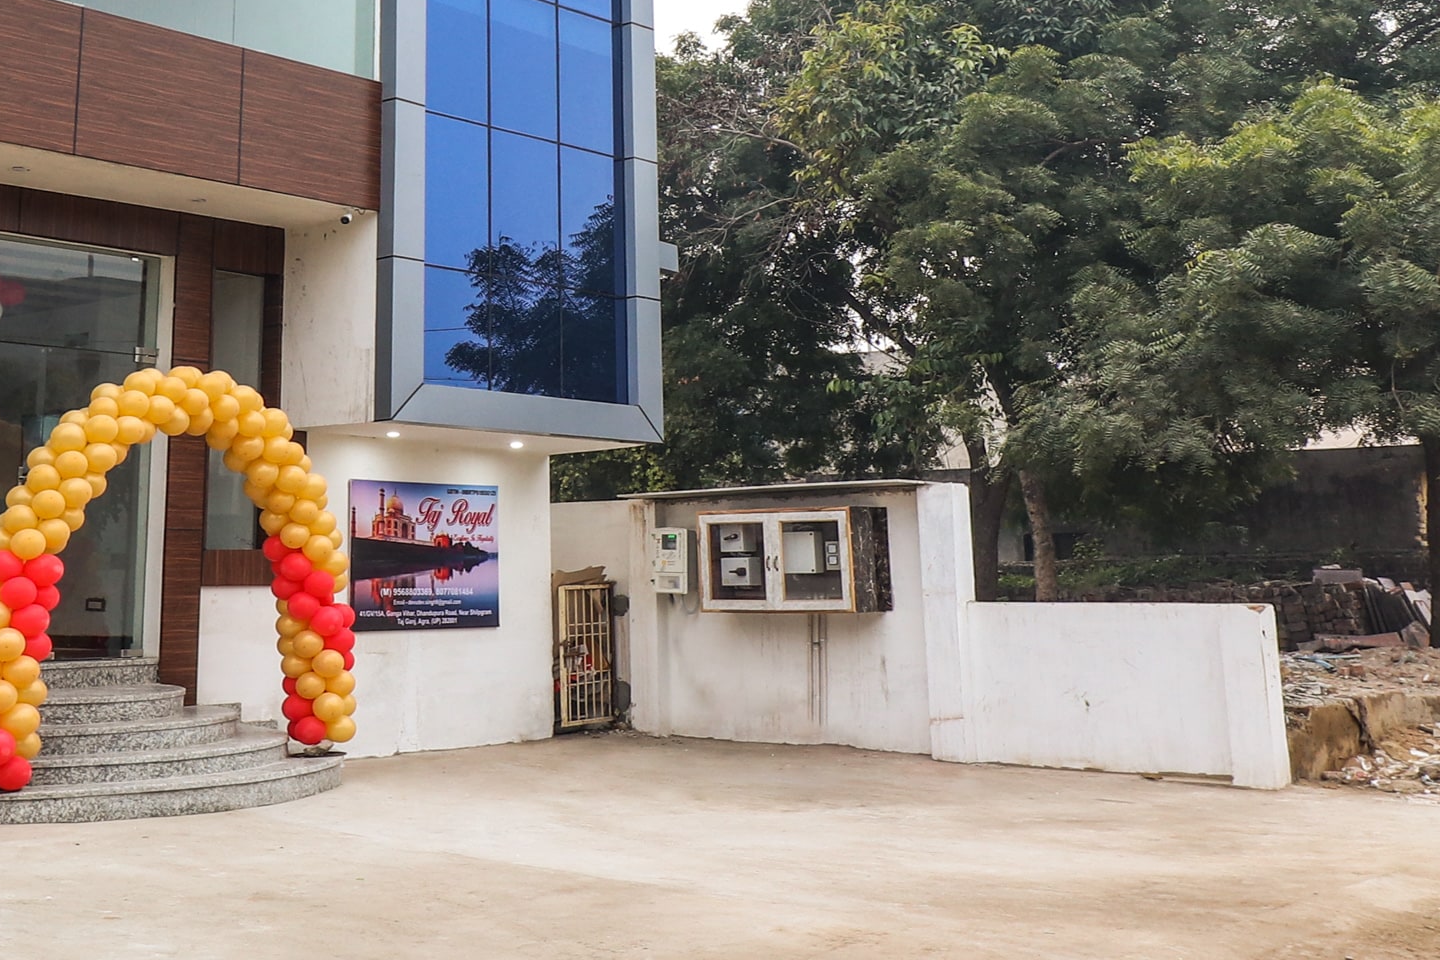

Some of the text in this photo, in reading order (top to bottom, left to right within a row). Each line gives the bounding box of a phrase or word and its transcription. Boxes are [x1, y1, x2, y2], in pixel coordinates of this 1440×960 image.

[415, 497, 495, 534] Taj Royal
[380, 588, 392, 598] (M)
